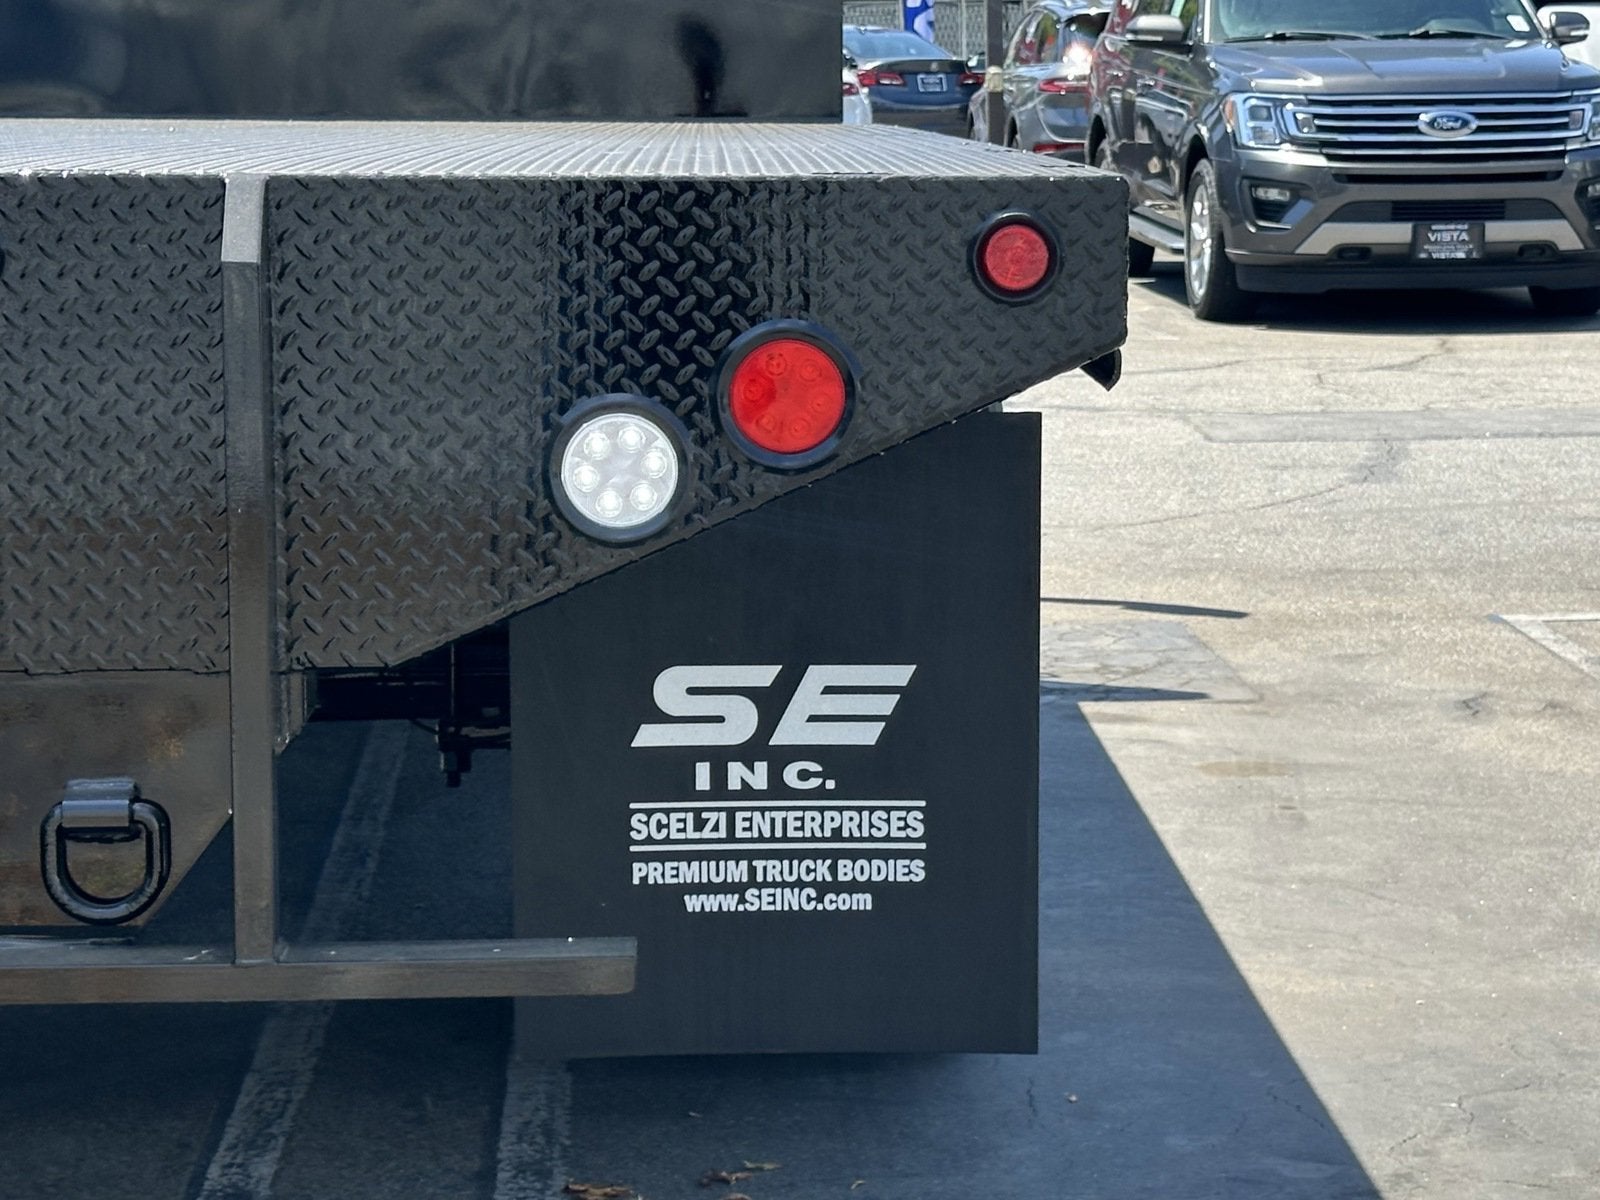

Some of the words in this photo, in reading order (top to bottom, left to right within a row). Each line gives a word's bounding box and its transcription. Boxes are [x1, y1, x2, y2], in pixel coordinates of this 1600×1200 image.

[1433, 117, 1463, 130] Ford
[1427, 231, 1470, 242] VISTA
[631, 665, 917, 747] SE
[695, 761, 836, 790] INC.
[630, 812, 727, 840] SCELZI
[735, 810, 925, 839] ENTERPRISES
[632, 860, 748, 885] PREMIUM
[752, 859, 833, 882] TRUCK
[837, 859, 926, 882] BODIES
[684, 887, 873, 912] www.SEINC.com
